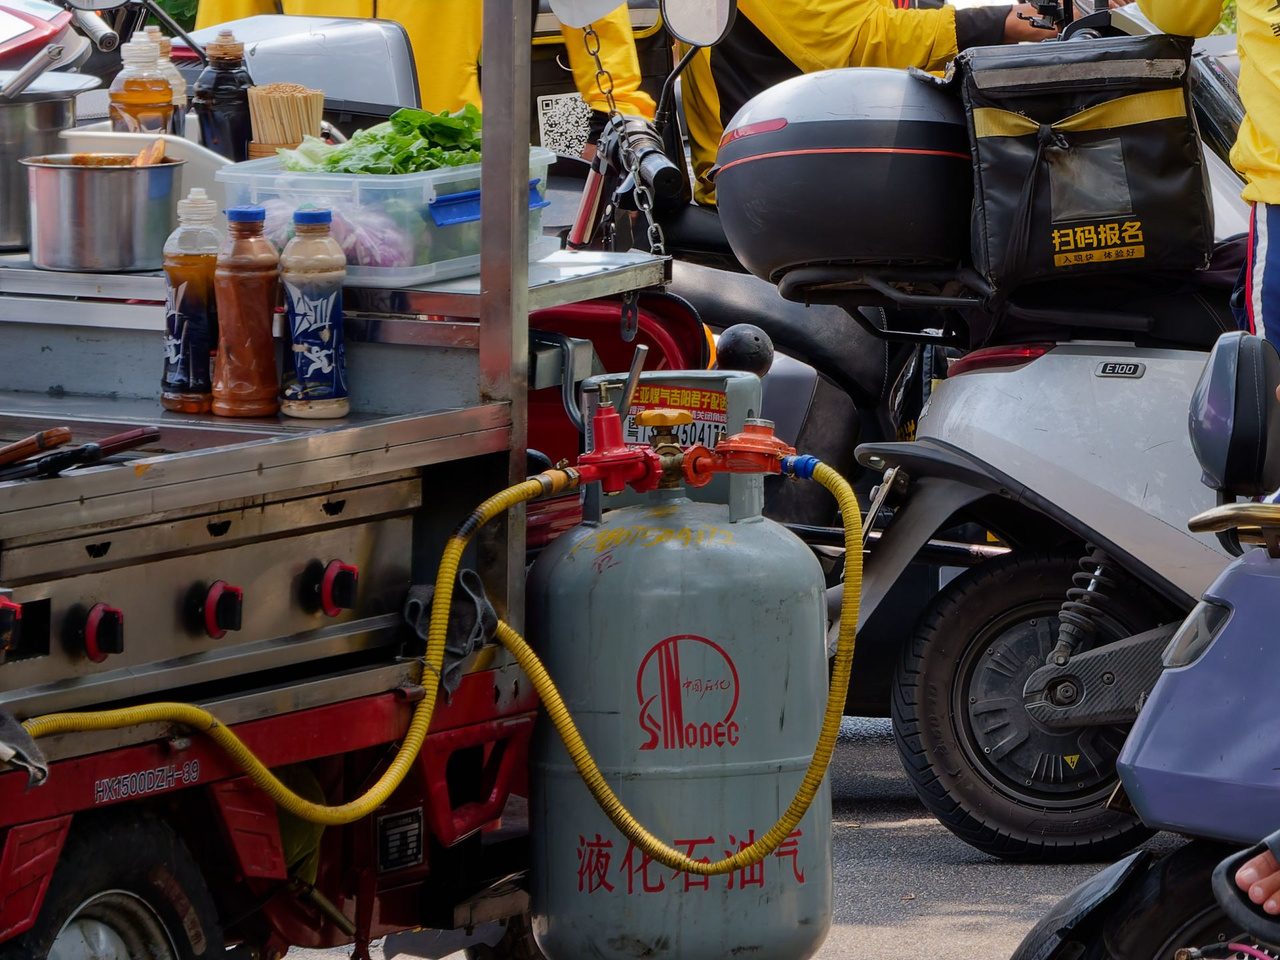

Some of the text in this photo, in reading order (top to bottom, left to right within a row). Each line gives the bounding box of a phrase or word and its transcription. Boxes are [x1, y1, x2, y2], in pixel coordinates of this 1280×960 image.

[1052, 221, 1144, 251] 扫码报名
[1104, 248, 1136, 259] 体验好
[1105, 364, 1135, 374] E100
[682, 677, 731, 700] 中国石化
[94, 759, 200, 804] HX1500DZH-39
[576, 829, 805, 895] 液化石油气
